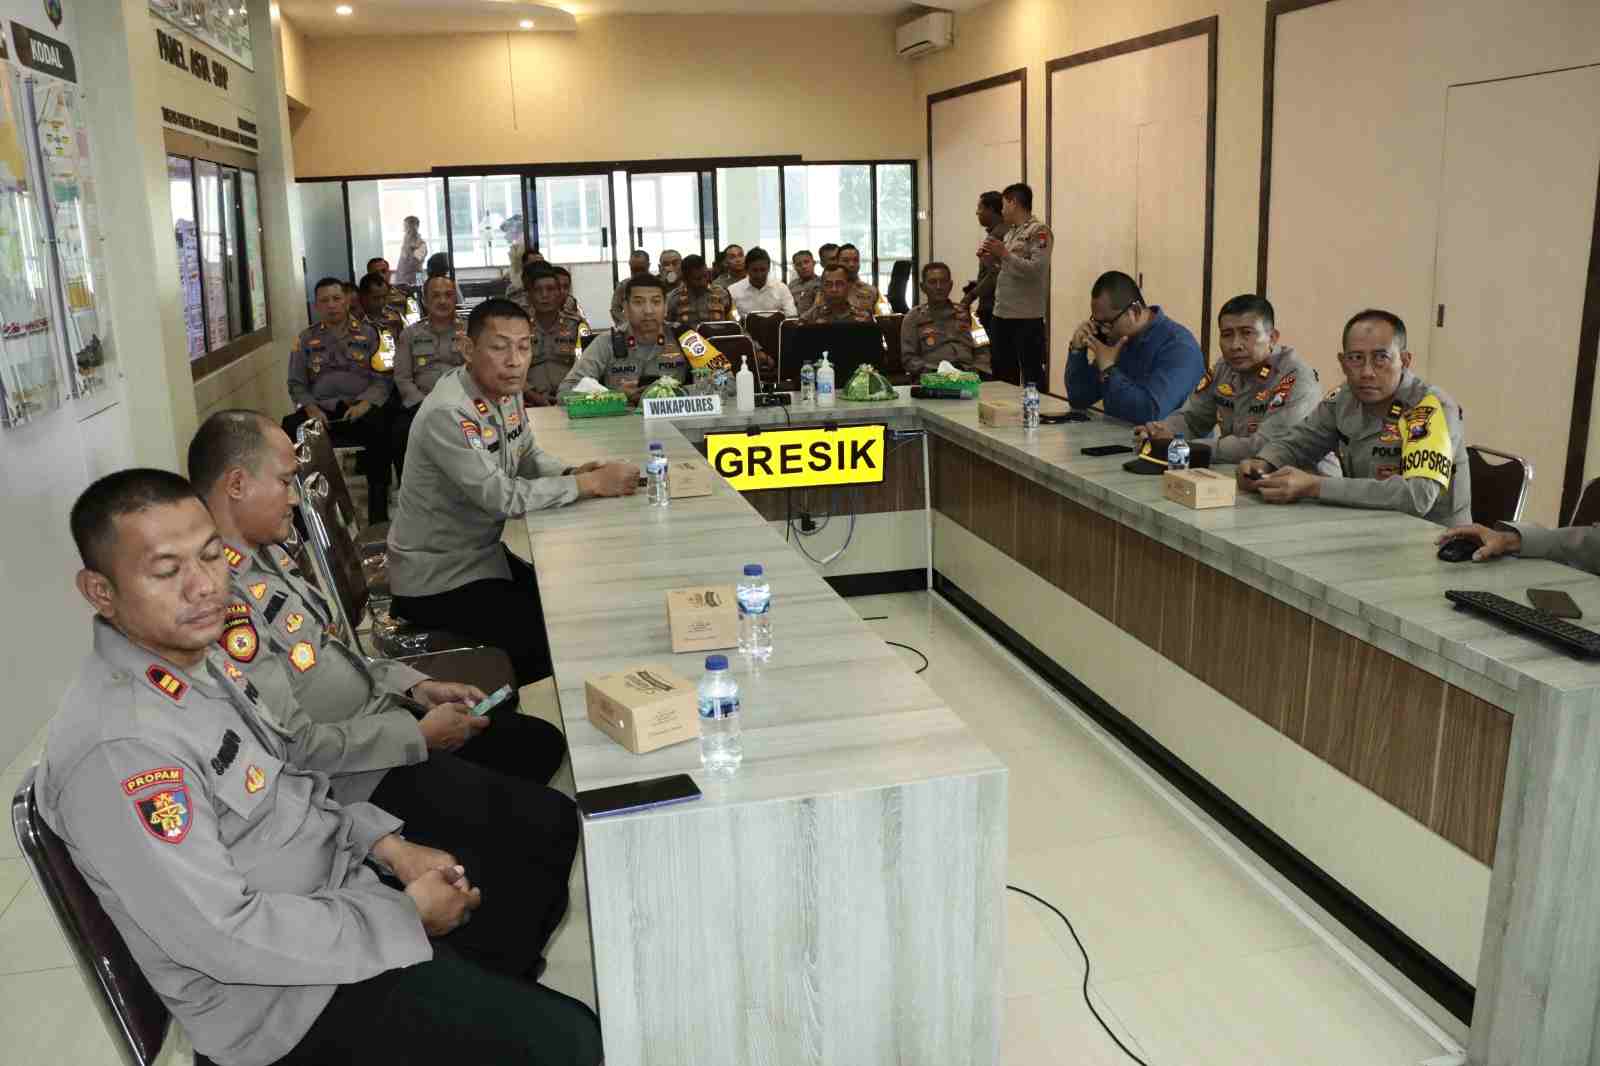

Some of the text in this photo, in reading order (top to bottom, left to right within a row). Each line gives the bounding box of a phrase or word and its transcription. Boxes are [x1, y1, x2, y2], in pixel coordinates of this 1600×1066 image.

[30, 37, 64, 69] KODAL
[649, 397, 714, 416] WAKAPOLRES
[714, 438, 877, 479] GRESIK
[127, 770, 179, 790] PROPAM
